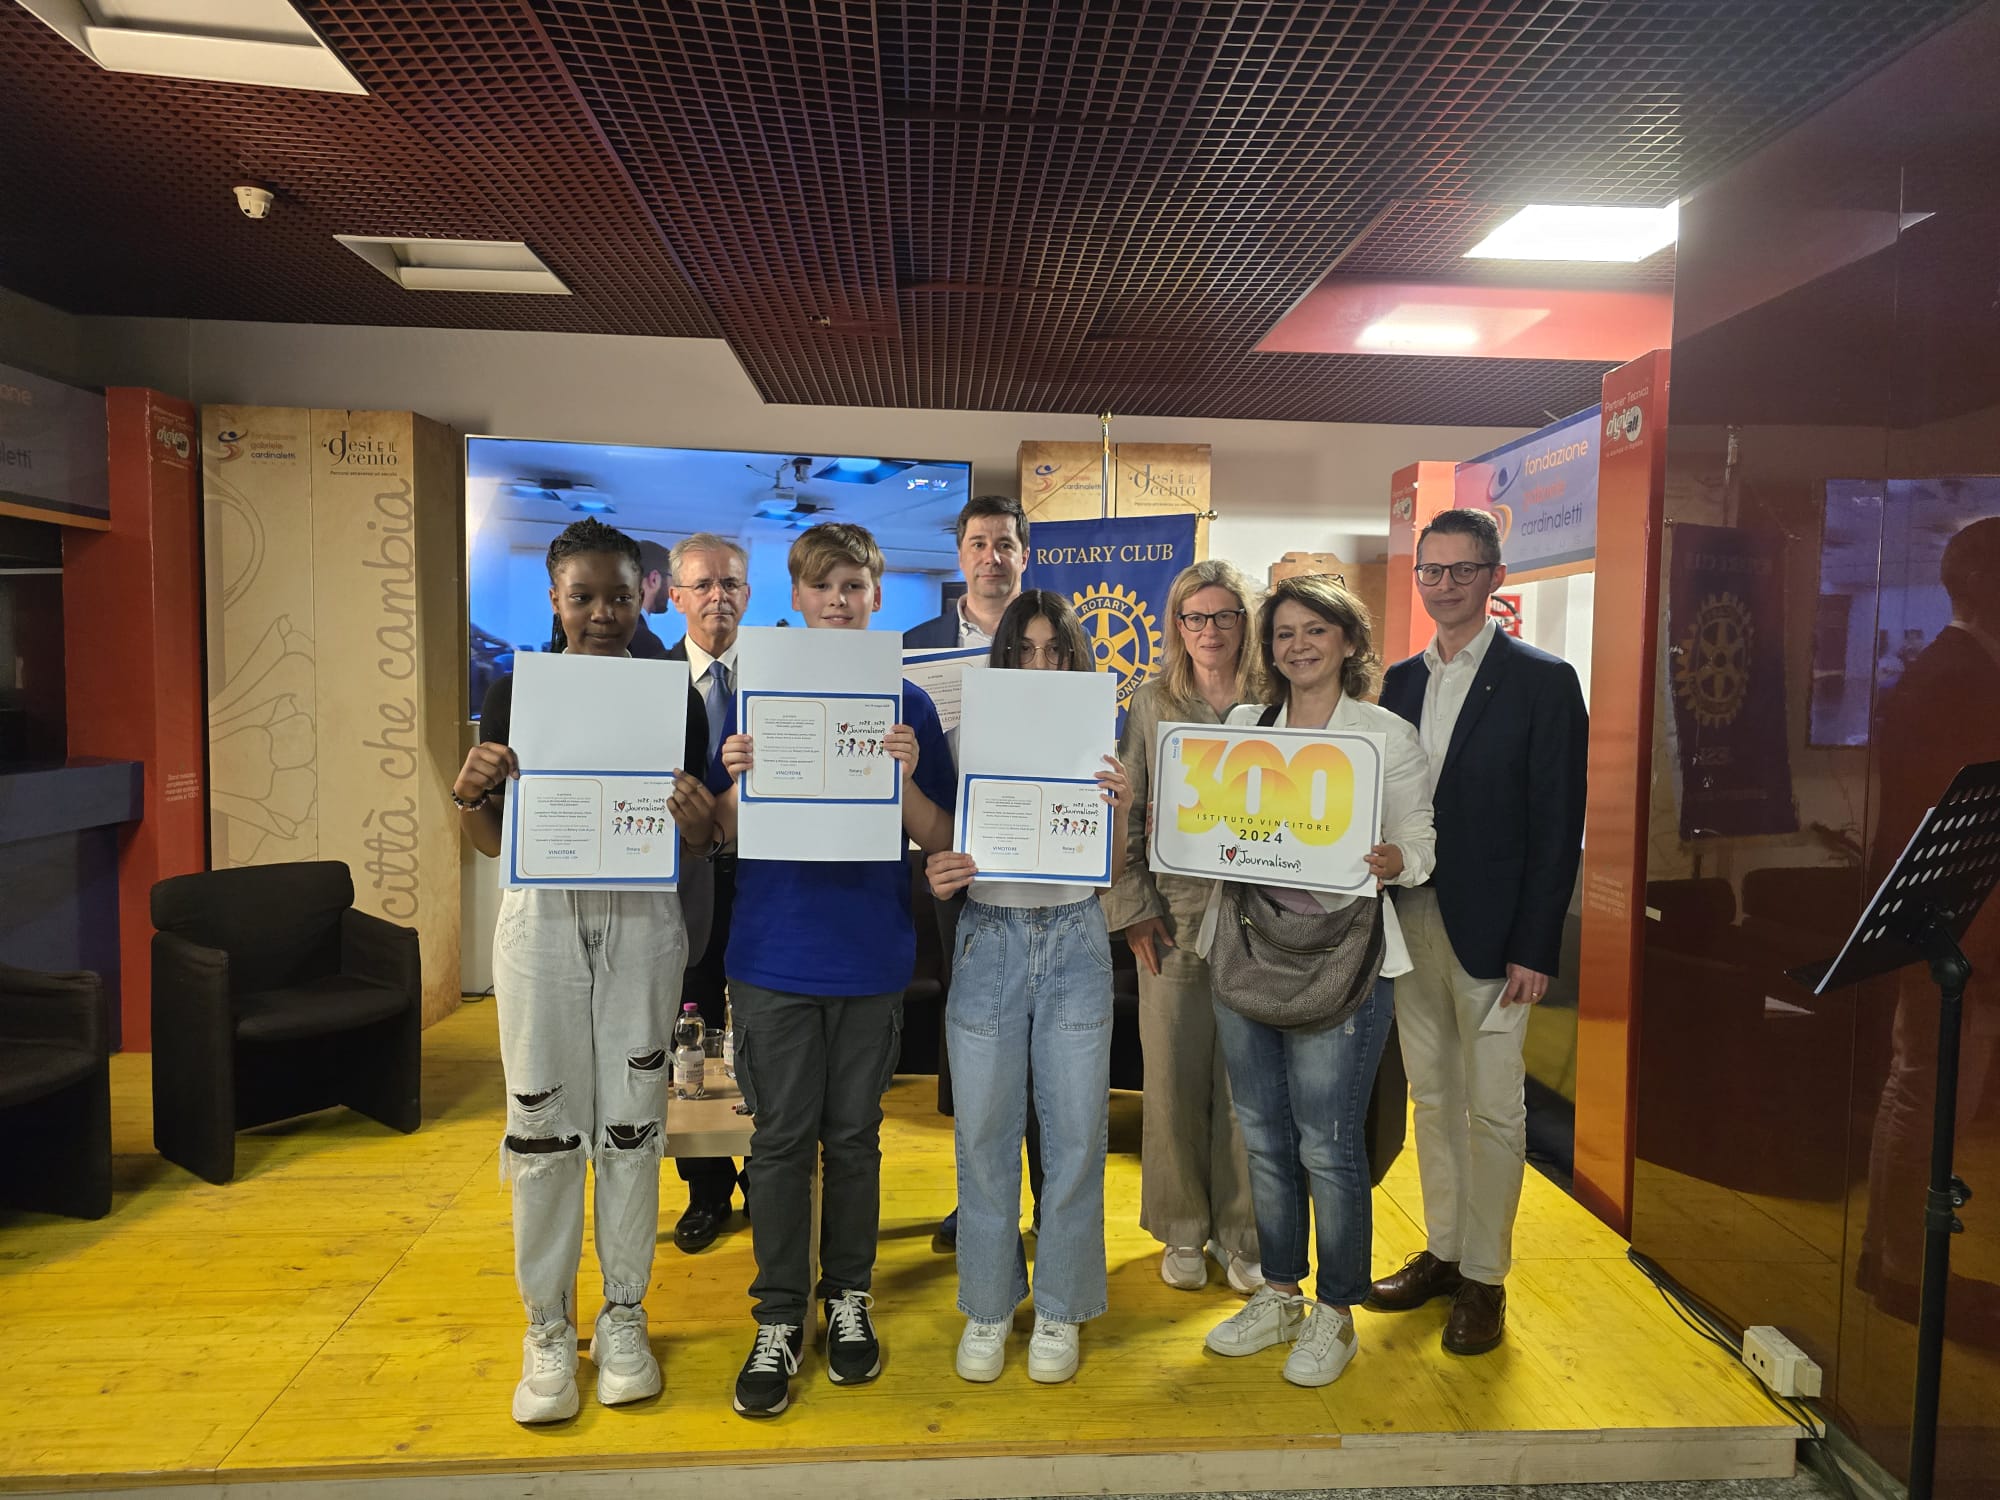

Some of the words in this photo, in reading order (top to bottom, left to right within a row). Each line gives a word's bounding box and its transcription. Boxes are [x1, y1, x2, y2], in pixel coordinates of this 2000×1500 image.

[250, 450, 296, 460] cardinaletti
[347, 452, 398, 466] cento
[1524, 439, 1589, 477] fondazione
[1521, 502, 1583, 537] cardinaletti
[1036, 546, 1116, 565] ROTARY
[1120, 543, 1174, 562] CLUB
[361, 477, 417, 680] cambia
[1081, 598, 1129, 614] ROTARY
[362, 696, 418, 780] che
[1177, 738, 1355, 847] 300
[1196, 813, 1254, 825] ISTITUTO
[1260, 819, 1331, 832] VINCITORE
[1239, 829, 1283, 844] 2024
[1239, 850, 1300, 870] Journalism
